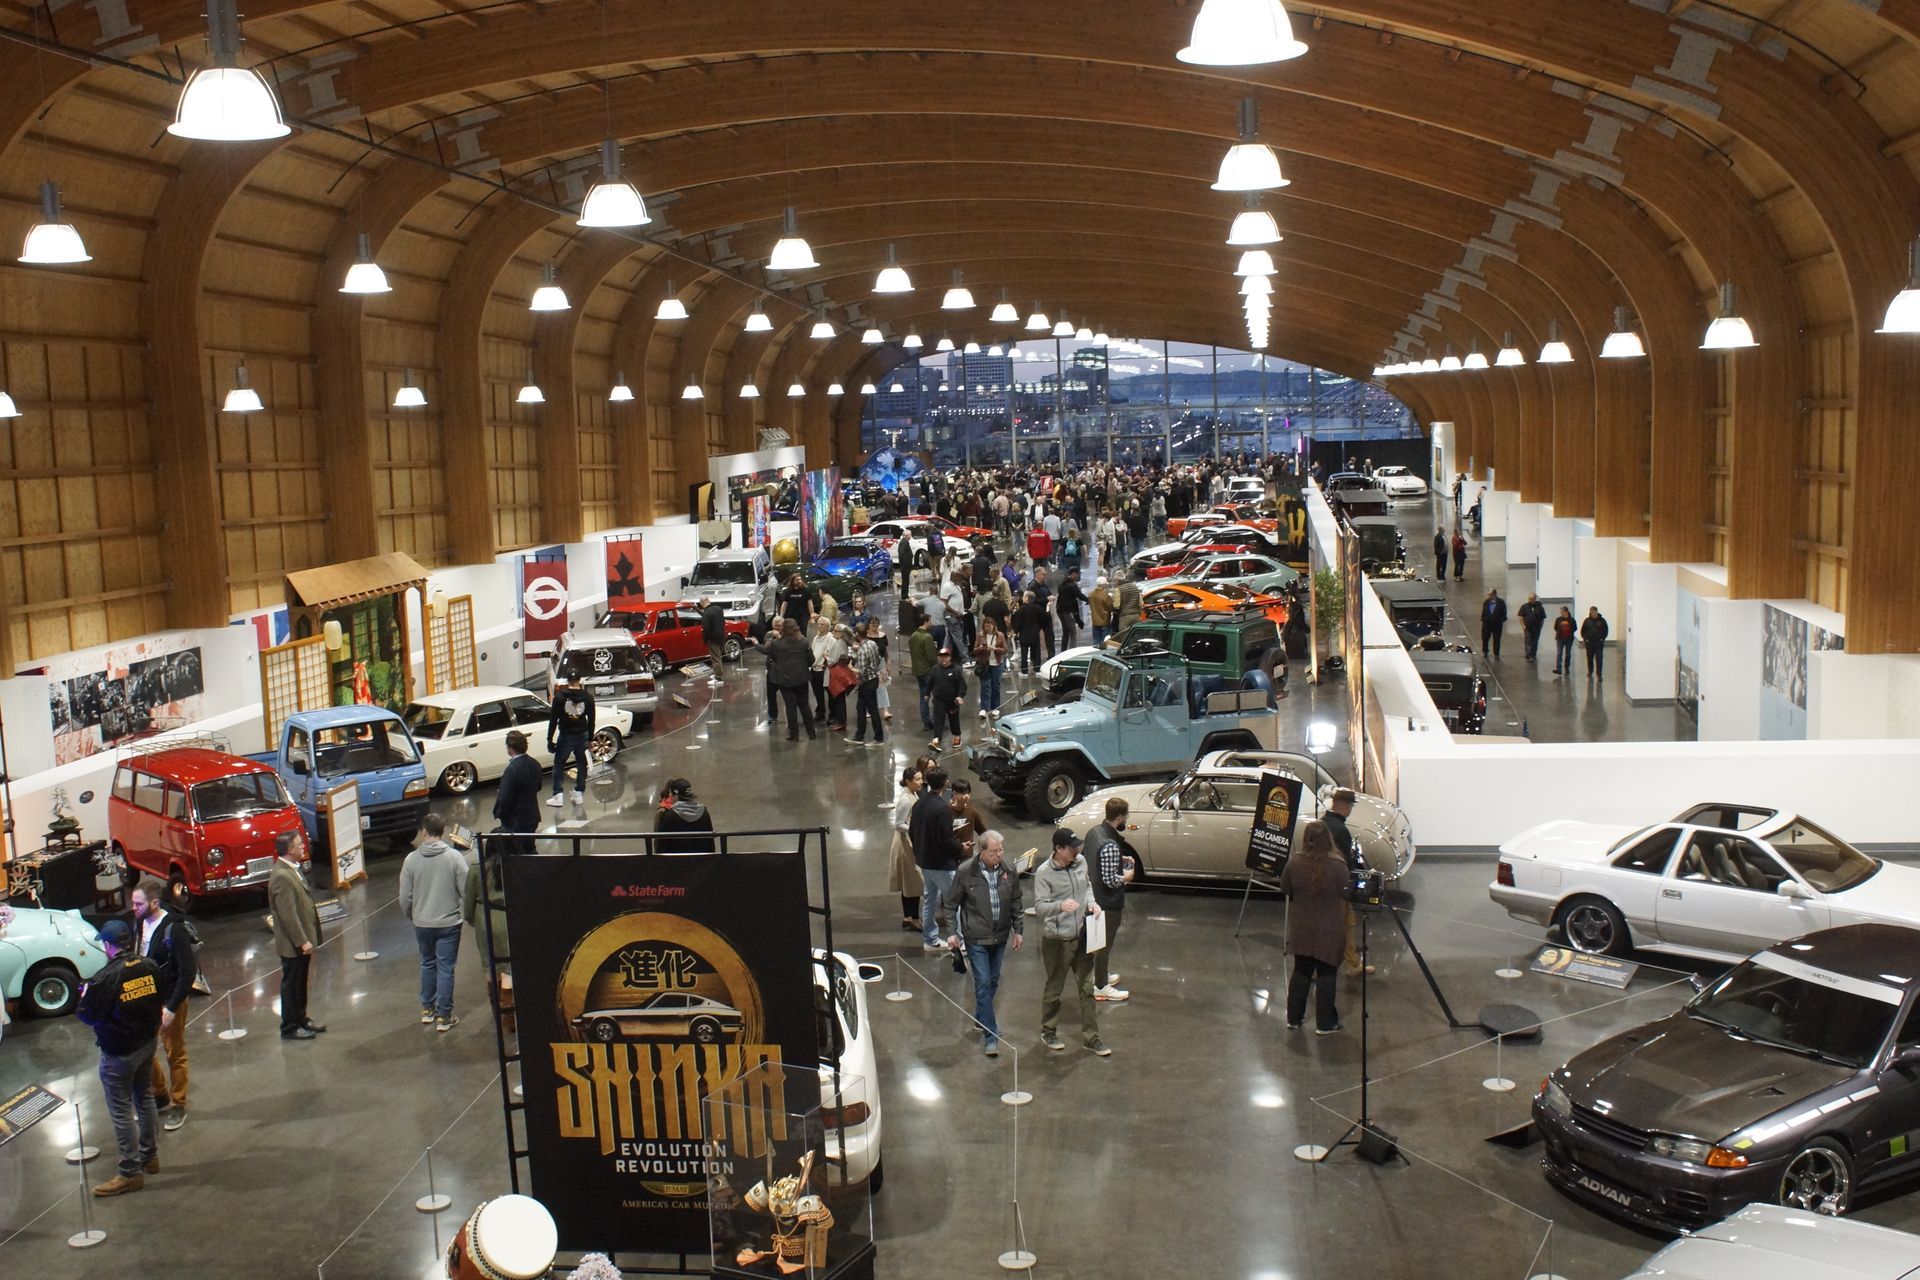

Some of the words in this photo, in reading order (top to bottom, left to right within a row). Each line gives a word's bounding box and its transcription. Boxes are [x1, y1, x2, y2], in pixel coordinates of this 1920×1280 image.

[1254, 829, 1264, 838] 360
[1265, 832, 1289, 846] CAMERA
[618, 950, 697, 989] 進化
[550, 1042, 788, 1158] SHINKA
[621, 1143, 727, 1157] EVOLUTION
[616, 1160, 734, 1174] REVOLUTION
[1578, 1176, 1631, 1206] ADVAN
